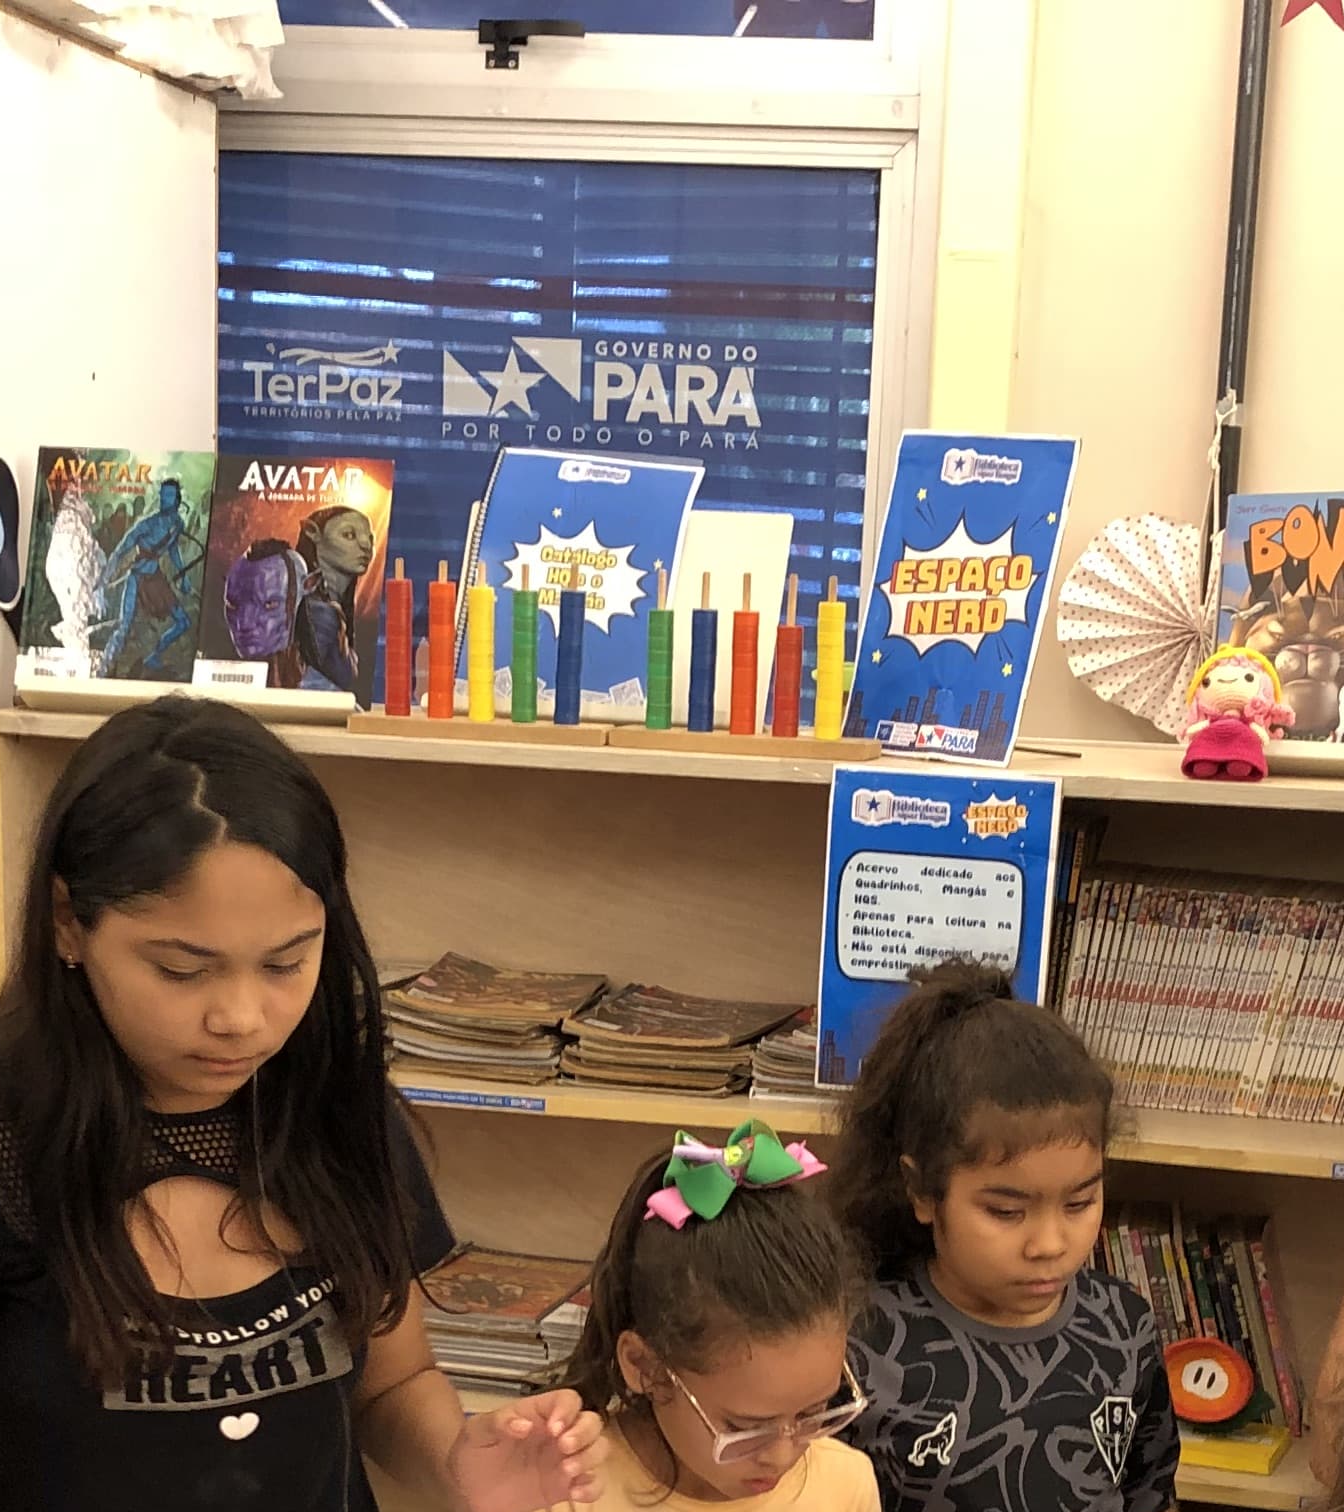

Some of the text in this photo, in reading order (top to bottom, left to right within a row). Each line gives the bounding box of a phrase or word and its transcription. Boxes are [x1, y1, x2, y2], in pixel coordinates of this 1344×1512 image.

[593, 339, 759, 362] GOVERNO DO
[242, 359, 404, 409] TerPaz
[337, 409, 371, 422] PELA
[375, 410, 403, 423] PAZ
[441, 420, 760, 451] POR TODO O PARÁ
[47, 455, 154, 485] AVATAR
[237, 460, 366, 494] AVATAR
[540, 544, 619, 570] Catálogo
[889, 554, 1033, 597] ESPAÇO
[904, 599, 1007, 635] NERD
[856, 862, 1016, 883] Acervo dedicado aos
[855, 878, 1014, 899] Quadrinhos, Mangás e
[852, 925, 915, 940] Biblioteca.
[853, 911, 1012, 931] Apenas para leitura na
[851, 940, 1010, 963] Não está disponível para
[193, 1304, 290, 1346] FOLLOW
[296, 1276, 340, 1310] YOU
[123, 1317, 328, 1404] HEART
